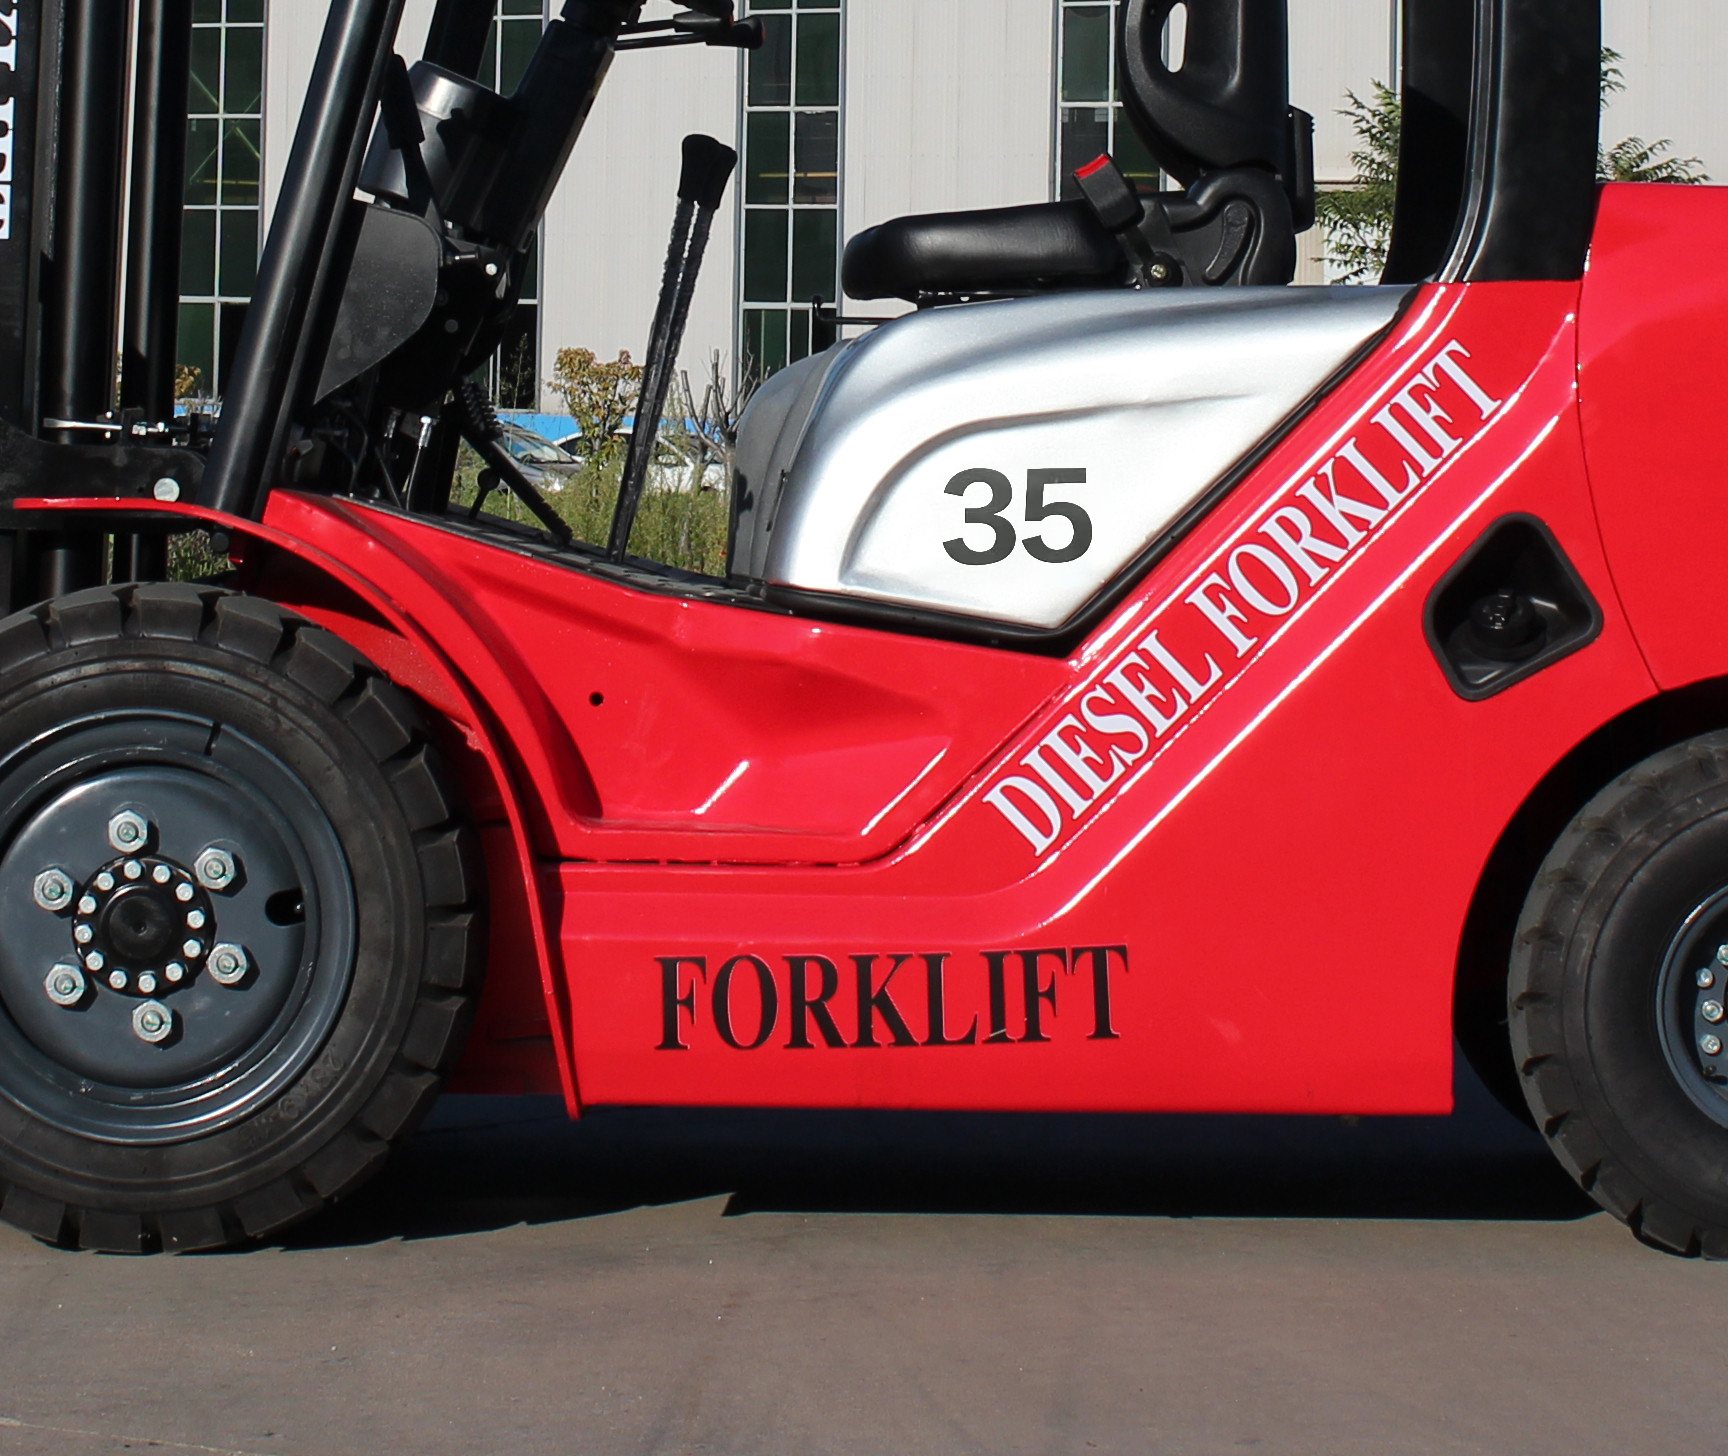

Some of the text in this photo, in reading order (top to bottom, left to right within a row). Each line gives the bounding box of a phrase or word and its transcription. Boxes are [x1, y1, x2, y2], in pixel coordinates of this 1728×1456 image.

[942, 467, 1094, 566] 35
[982, 339, 1502, 857] DIESEL FORKLIFT
[653, 944, 1129, 1050] FORKLIFT
